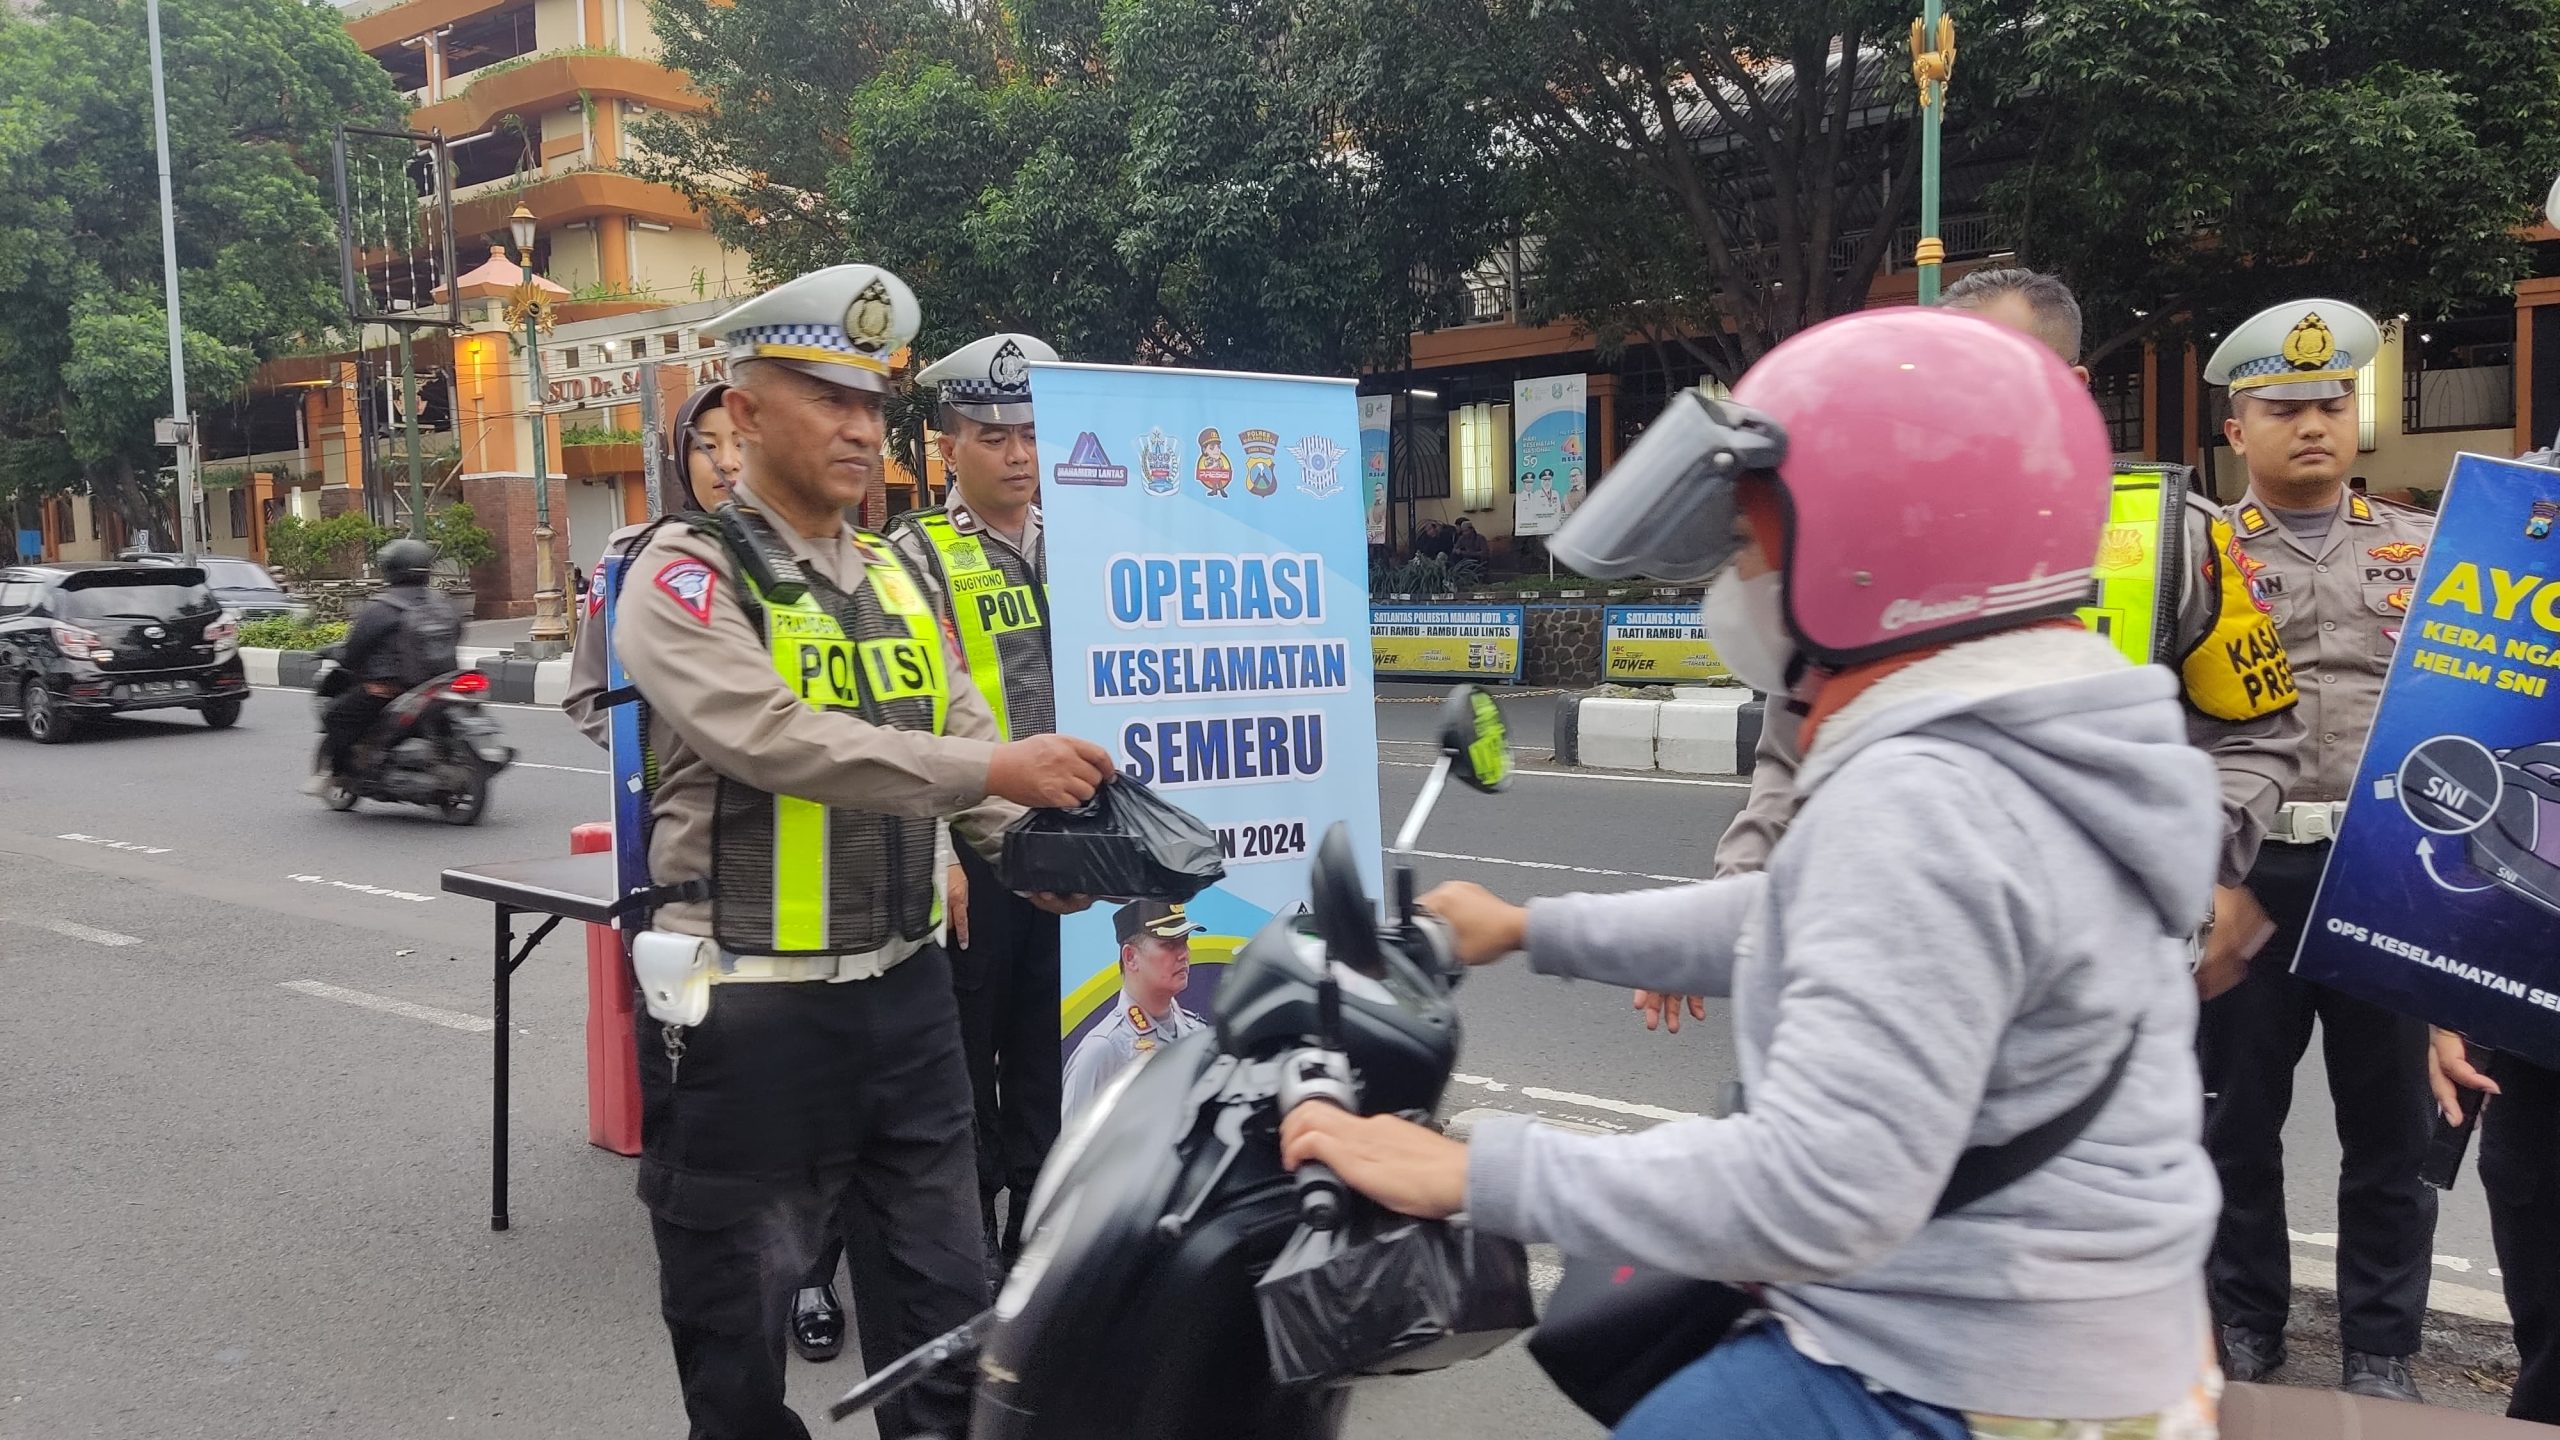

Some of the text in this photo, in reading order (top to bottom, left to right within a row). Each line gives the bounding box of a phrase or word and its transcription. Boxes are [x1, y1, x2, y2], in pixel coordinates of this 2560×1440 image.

[547, 378, 585, 404] SUD
[589, 375, 617, 398] Dr.
[1523, 454, 1538, 468] 59
[1098, 468, 1124, 479] LANTAS
[954, 573, 1002, 593] SUGIYONO
[1110, 558, 1321, 623] OPERASI
[976, 589, 1037, 632] POL
[1374, 611, 1501, 624] SATLANTAS POLRESTA MALANG KOTA
[1626, 612, 1673, 624] SATLANTAS
[1370, 626, 1388, 636] AATI
[1390, 626, 1420, 636] RAMBU
[1427, 626, 1457, 637] RAMBU
[1459, 627, 1479, 637] LALU
[1481, 627, 1511, 637] LINTAS
[1617, 628, 1643, 639] TAATI
[1646, 628, 1682, 639] RAMBU
[2422, 620, 2498, 654] KERA
[1092, 643, 1346, 697] KESELAMATAN
[1373, 655, 1399, 666] WER
[1611, 659, 1655, 673] POWER
[2413, 649, 2548, 698] HELM SNI
[1124, 714, 1323, 786] SEMERU
[2423, 776, 2470, 809] SNI
[1242, 822, 1306, 858] 2024
[2496, 866, 2519, 883] SNI
[2326, 917, 2369, 943] OPS
[2370, 931, 2527, 999] KESELAMATAN
